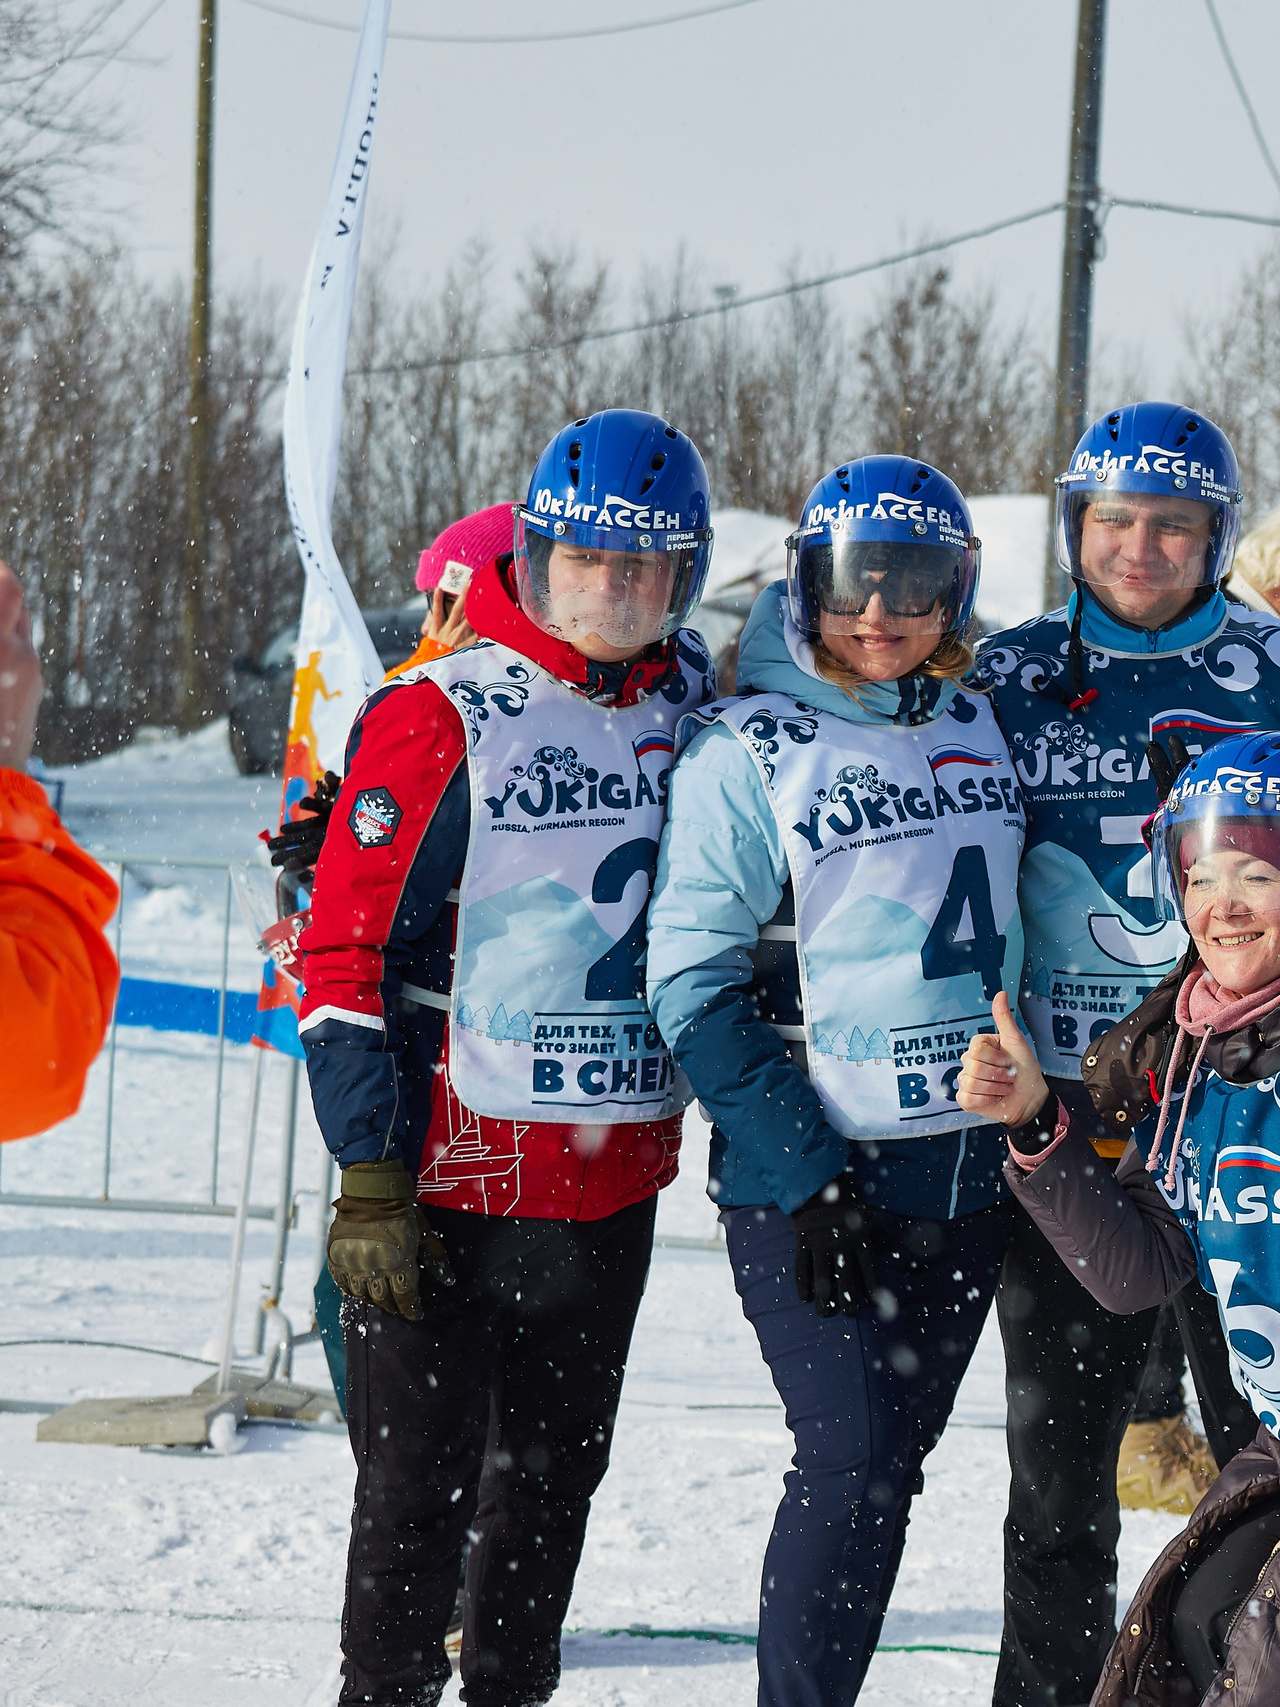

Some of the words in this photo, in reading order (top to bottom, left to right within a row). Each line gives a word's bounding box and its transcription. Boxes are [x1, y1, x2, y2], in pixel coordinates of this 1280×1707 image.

[1201, 481, 1227, 493] ПЕРВЫЕ
[1206, 491, 1231, 504] РОССИИ
[667, 532, 695, 542] ПЕРВЫЕ
[673, 541, 699, 550] РОССИИ
[1033, 791, 1085, 802] MURMANSK
[1088, 789, 1125, 799] REGION
[361, 805, 389, 825] RUSSIA
[491, 823, 530, 834] RUSSIA,
[533, 819, 587, 832] MURMANSK
[589, 817, 625, 828] REGION
[815, 844, 847, 867] RUSSIA,
[849, 831, 902, 850] MURMANSK
[904, 826, 934, 840] REGION
[585, 836, 660, 1001] 2
[920, 844, 1007, 1002] 4
[1051, 982, 1085, 997] ДЛЯ
[1051, 1000, 1077, 1011] КТО
[1080, 1002, 1127, 1013] ЗНАЕТ
[534, 1025, 574, 1041] ДЛЯ
[576, 1024, 616, 1040] ТЕХ,
[533, 1042, 567, 1054] КТО
[568, 1042, 616, 1054] ЗНАЕТ
[893, 1036, 932, 1055] ДЛЯ
[934, 1030, 971, 1050] ТЕХ,
[894, 1053, 926, 1068] КТО
[533, 1059, 565, 1093] В
